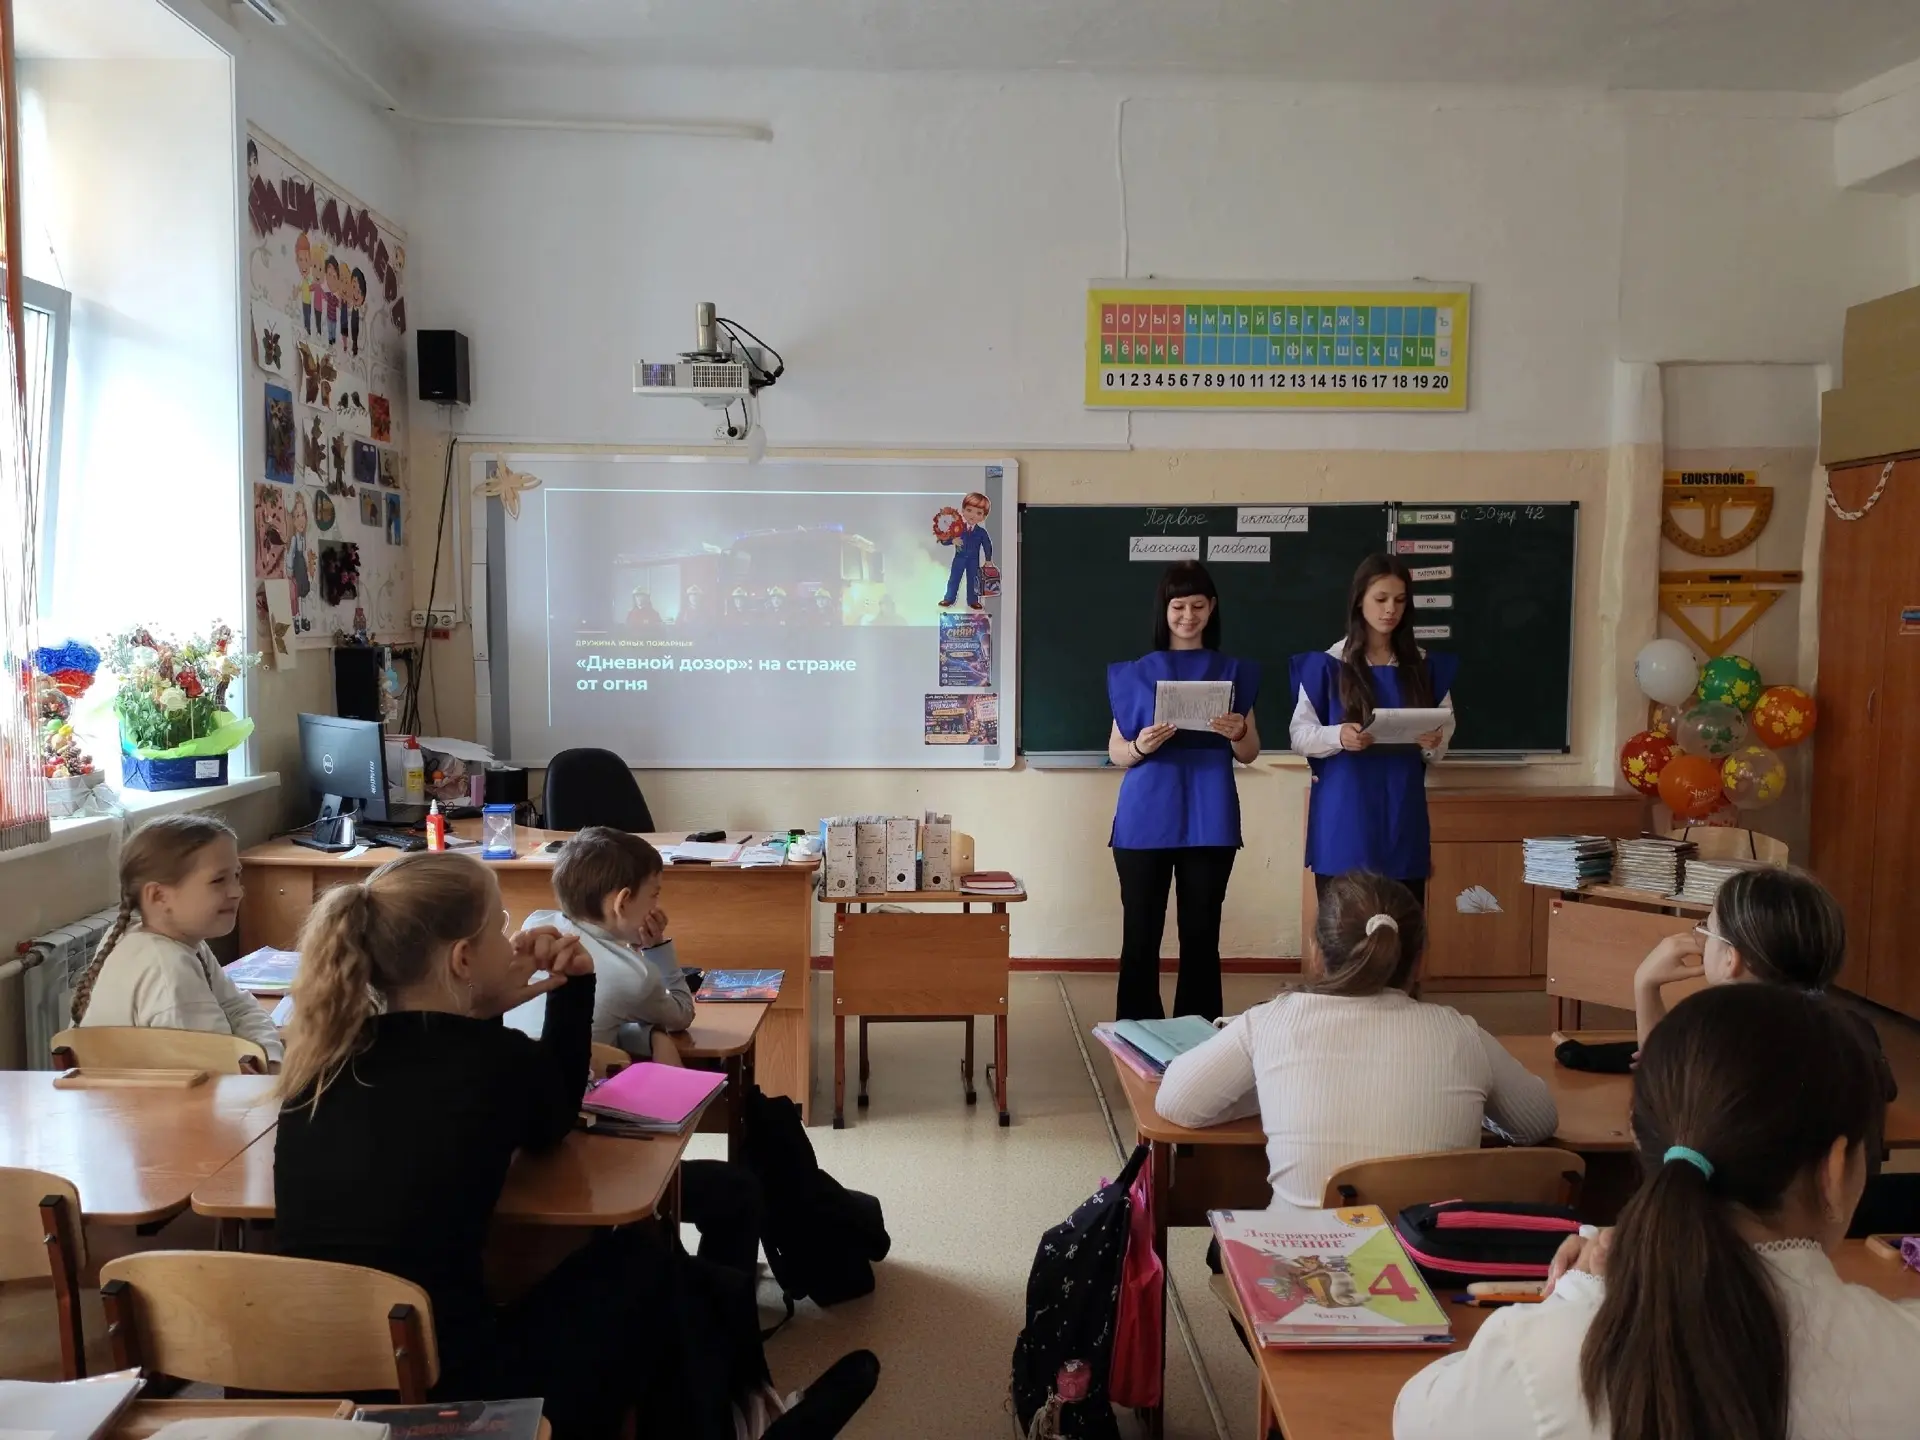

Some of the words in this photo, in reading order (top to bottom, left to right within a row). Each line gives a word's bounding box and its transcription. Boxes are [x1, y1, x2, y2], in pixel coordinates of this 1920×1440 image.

[1105, 314, 1113, 324] а
[1122, 314, 1131, 324] о
[1139, 314, 1147, 327] у
[1154, 314, 1165, 324] ы
[1173, 314, 1181, 324] э
[1189, 315, 1197, 324] н
[1205, 315, 1215, 324] м
[1221, 315, 1231, 324] л
[1240, 315, 1248, 327] р
[1256, 312, 1264, 324] й
[1272, 312, 1281, 325] б
[1290, 315, 1298, 325] в
[1307, 315, 1314, 325] г
[1322, 316, 1332, 327] д
[1339, 316, 1350, 325] ж
[1104, 344, 1112, 354] я
[1122, 340, 1129, 354] ё
[1136, 344, 1148, 354] ю
[1156, 344, 1163, 354] и
[1172, 344, 1178, 355] е
[1272, 345, 1279, 355] п
[1287, 342, 1299, 358] ф
[1306, 346, 1313, 356] к
[1323, 346, 1330, 356] т
[1338, 346, 1349, 356] ш
[1356, 346, 1363, 356] с
[1372, 346, 1380, 356] х
[1390, 346, 1398, 358] ц
[1406, 346, 1413, 356] ч
[1421, 346, 1433, 359] щ
[1107, 373, 1114, 387] 0
[1120, 373, 1124, 387] 1
[1131, 373, 1138, 387] 2
[1144, 373, 1151, 387] 3
[1156, 373, 1163, 387] 4
[1168, 373, 1175, 387] 5
[1180, 373, 1188, 387] 6
[1192, 373, 1200, 387] 7
[1205, 373, 1212, 387] 8
[1217, 373, 1224, 387] 9
[1230, 373, 1244, 387] 10
[1250, 373, 1264, 387] 11
[1270, 373, 1285, 387] 12
[1290, 374, 1305, 387] 13
[1310, 375, 1326, 387] 14
[1331, 375, 1346, 388] 15
[1352, 375, 1367, 388] 16
[1372, 375, 1387, 388] 17
[1393, 375, 1407, 388] 18
[1413, 375, 1428, 388] 19
[1433, 376, 1448, 388] 20
[1682, 472, 1744, 485] EDUSTRONG
[1526, 506, 1545, 519] 42
[1144, 508, 1208, 533] Первое
[1241, 508, 1306, 530] октября
[1132, 538, 1197, 553] Классная
[1210, 538, 1268, 560] работа
[577, 655, 674, 672] «Дневной
[680, 657, 752, 673] дозор»:
[759, 658, 780, 670] на
[786, 658, 856, 674] страже
[577, 679, 597, 690] от
[603, 679, 648, 691] огня
[1245, 1229, 1356, 1243] Литературное
[1264, 1239, 1345, 1249] ЧТЕНИЕ
[1368, 1264, 1420, 1301] 4
